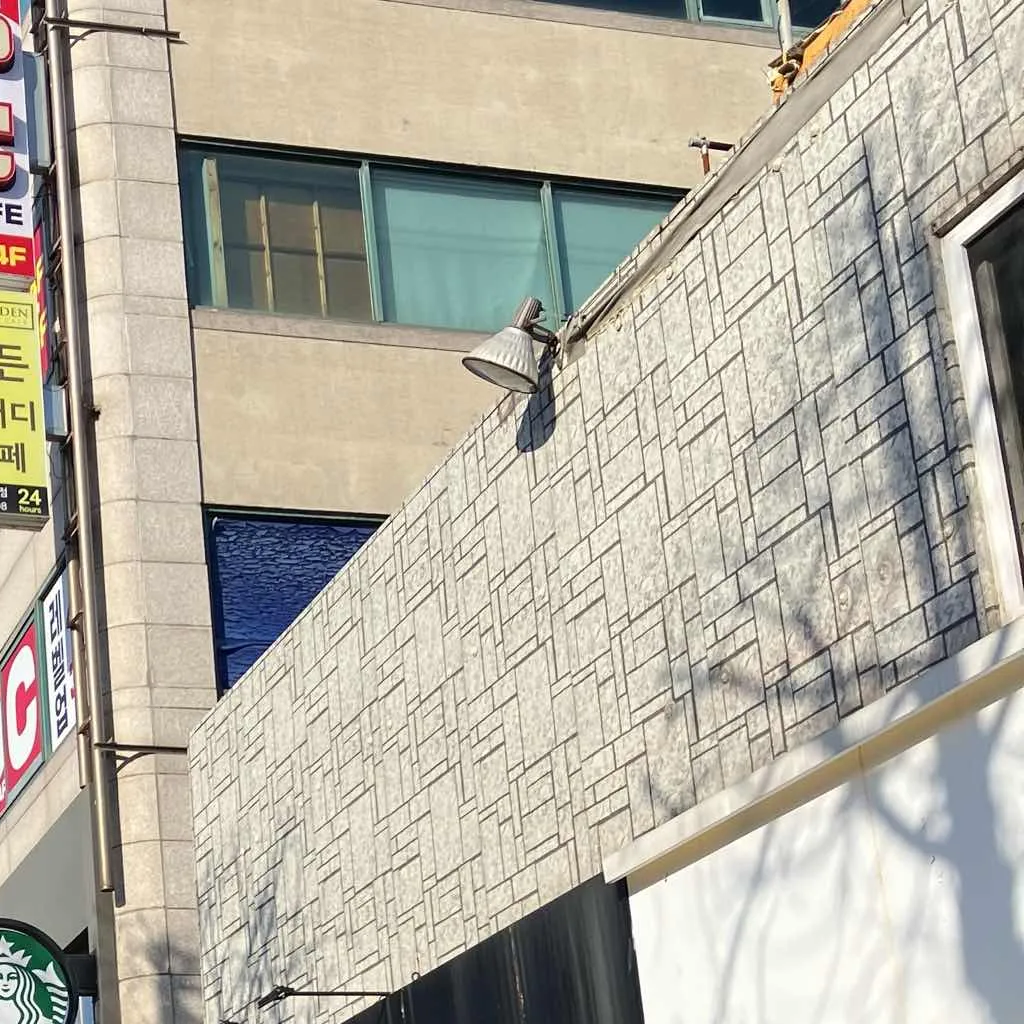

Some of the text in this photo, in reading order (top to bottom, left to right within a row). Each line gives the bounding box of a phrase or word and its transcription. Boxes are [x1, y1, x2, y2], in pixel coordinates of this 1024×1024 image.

[18, 488, 42, 505] 24
[19, 505, 42, 514] hours
[49, 589, 70, 738] 레벨업
